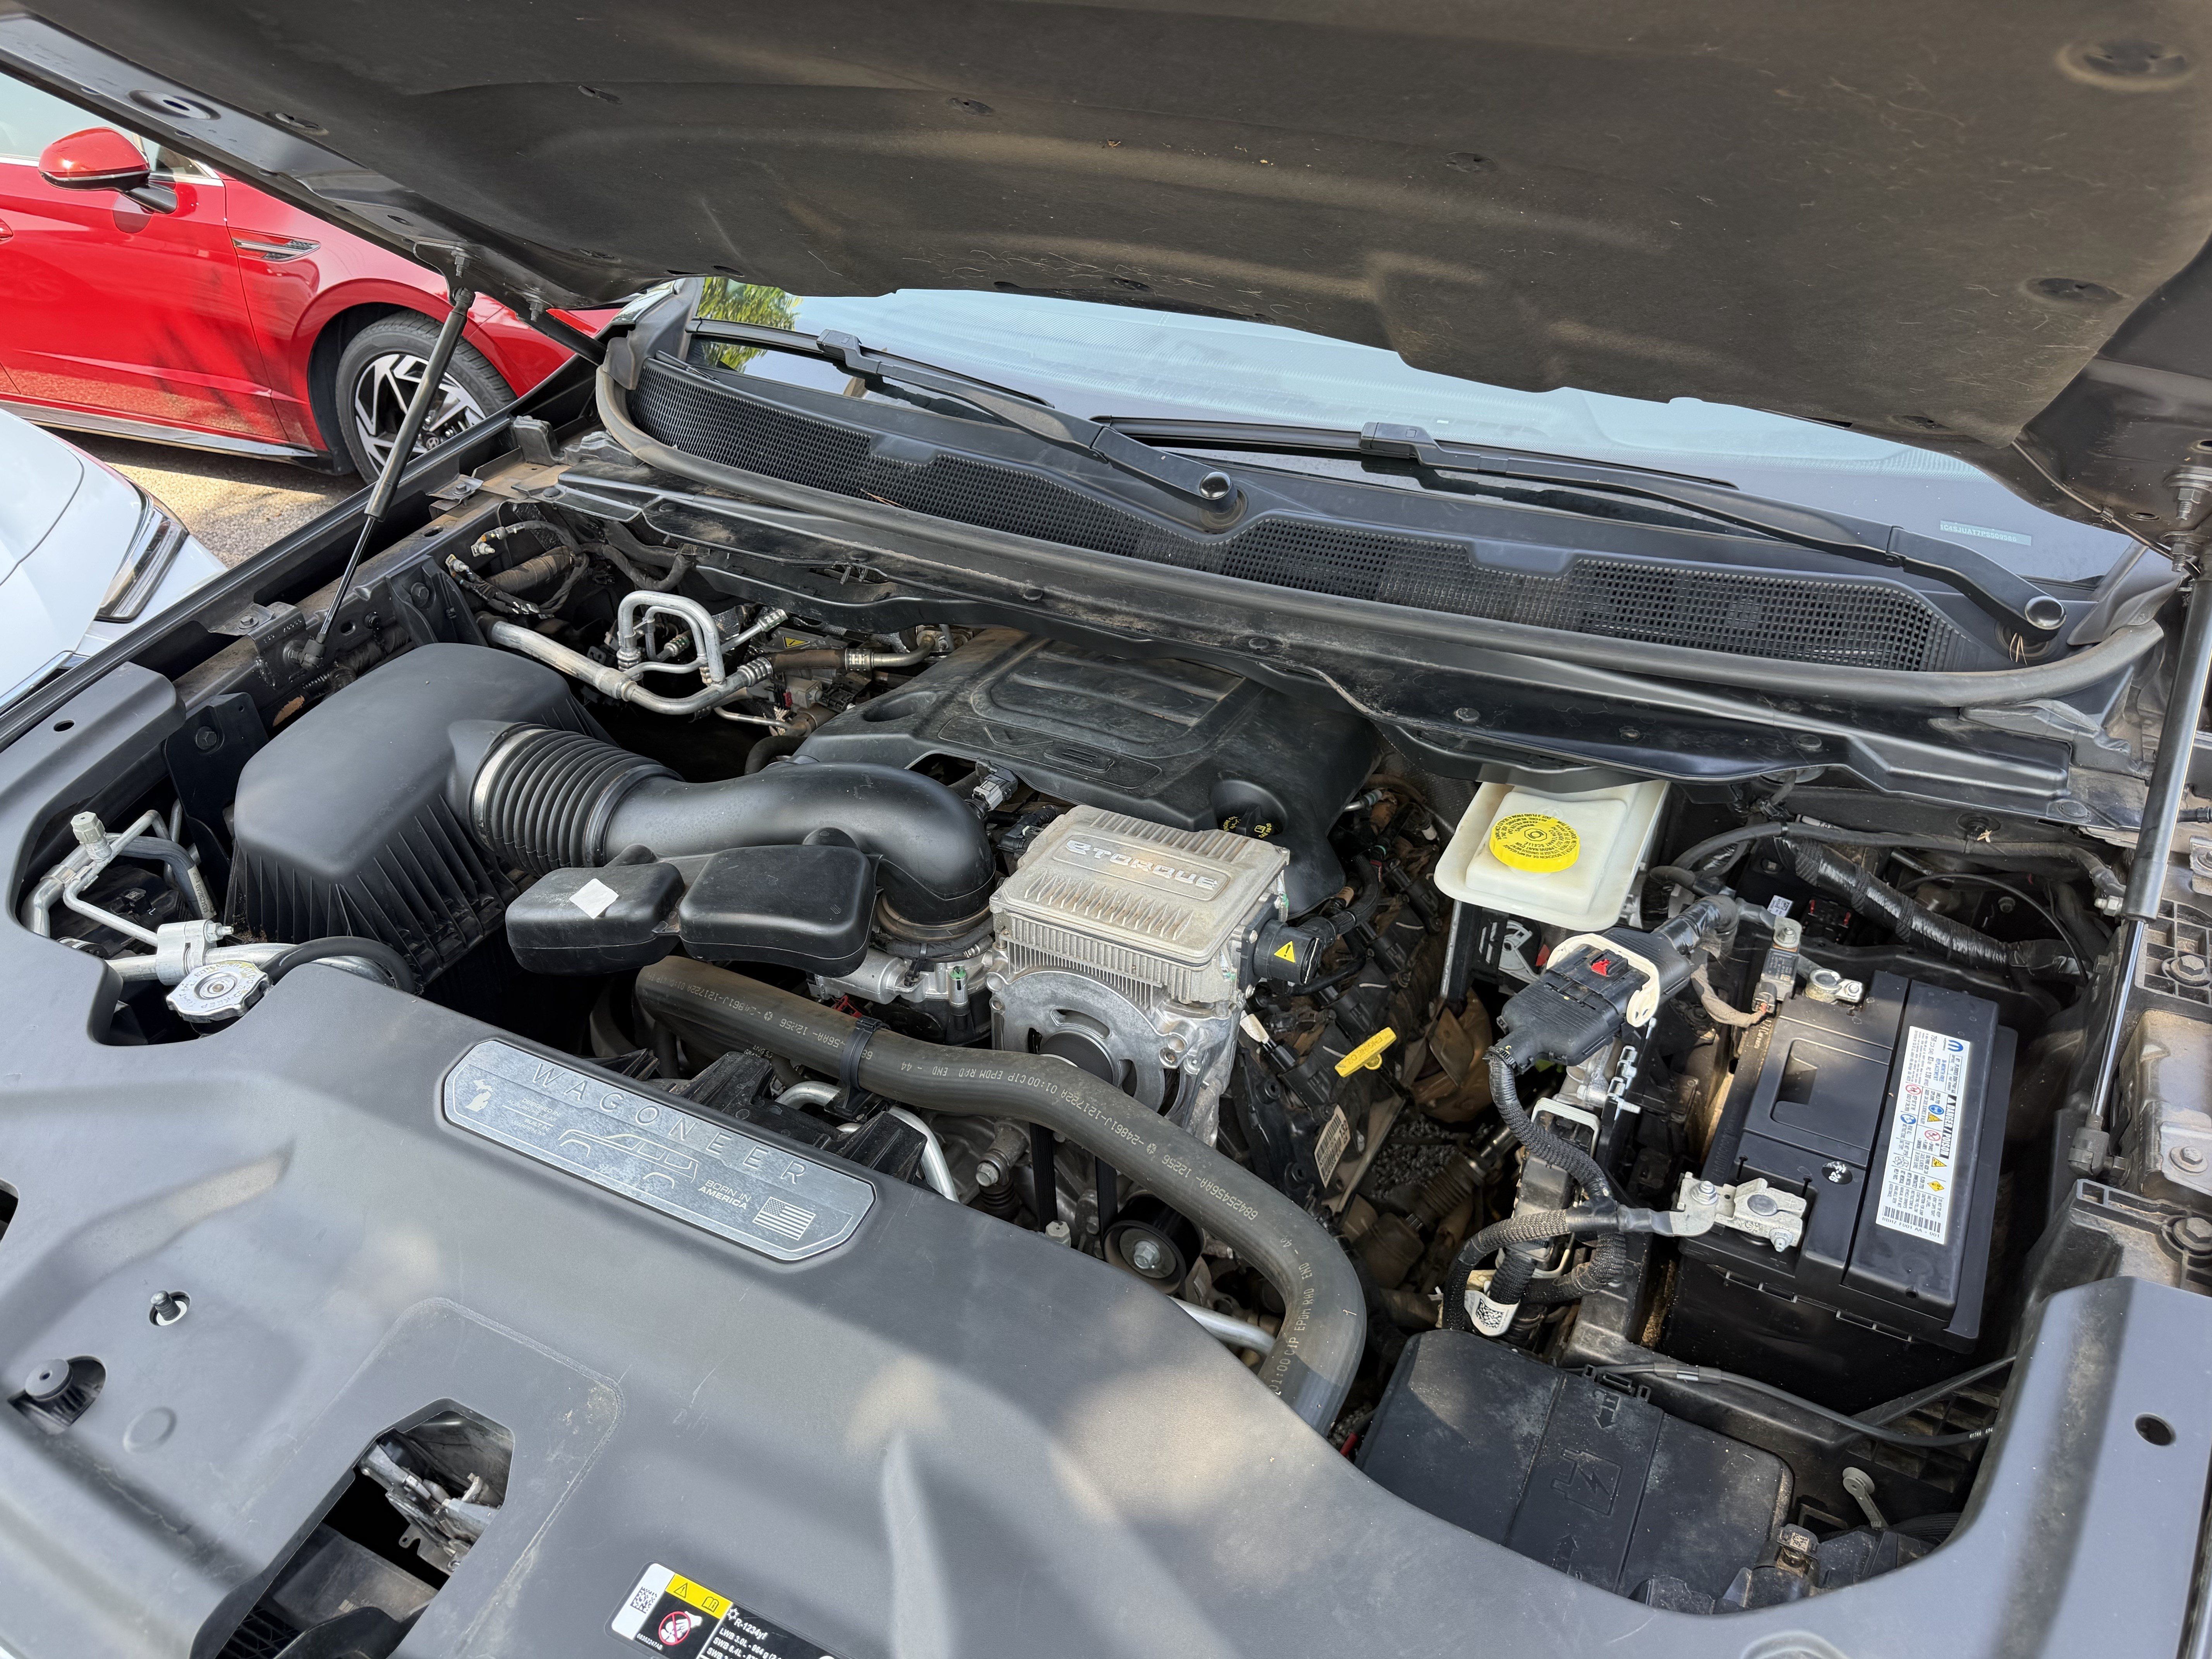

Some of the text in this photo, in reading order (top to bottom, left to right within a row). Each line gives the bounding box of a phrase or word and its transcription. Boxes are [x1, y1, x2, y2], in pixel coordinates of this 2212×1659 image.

[931, 1065, 948, 1077] END
[523, 1118, 543, 1128] BUILT
[532, 1062, 809, 1185] WAGONEER
[1945, 1103, 1956, 1128] DANGER
[1941, 1133, 1952, 1157] POISON
[696, 1185, 749, 1209] AMERICA
[704, 1179, 752, 1203] BORN IN
[719, 1628, 735, 1640] LWB
[735, 1635, 747, 1647] 3.0L
[734, 1618, 768, 1640] R-1234yf
[713, 1637, 730, 1650] SWB
